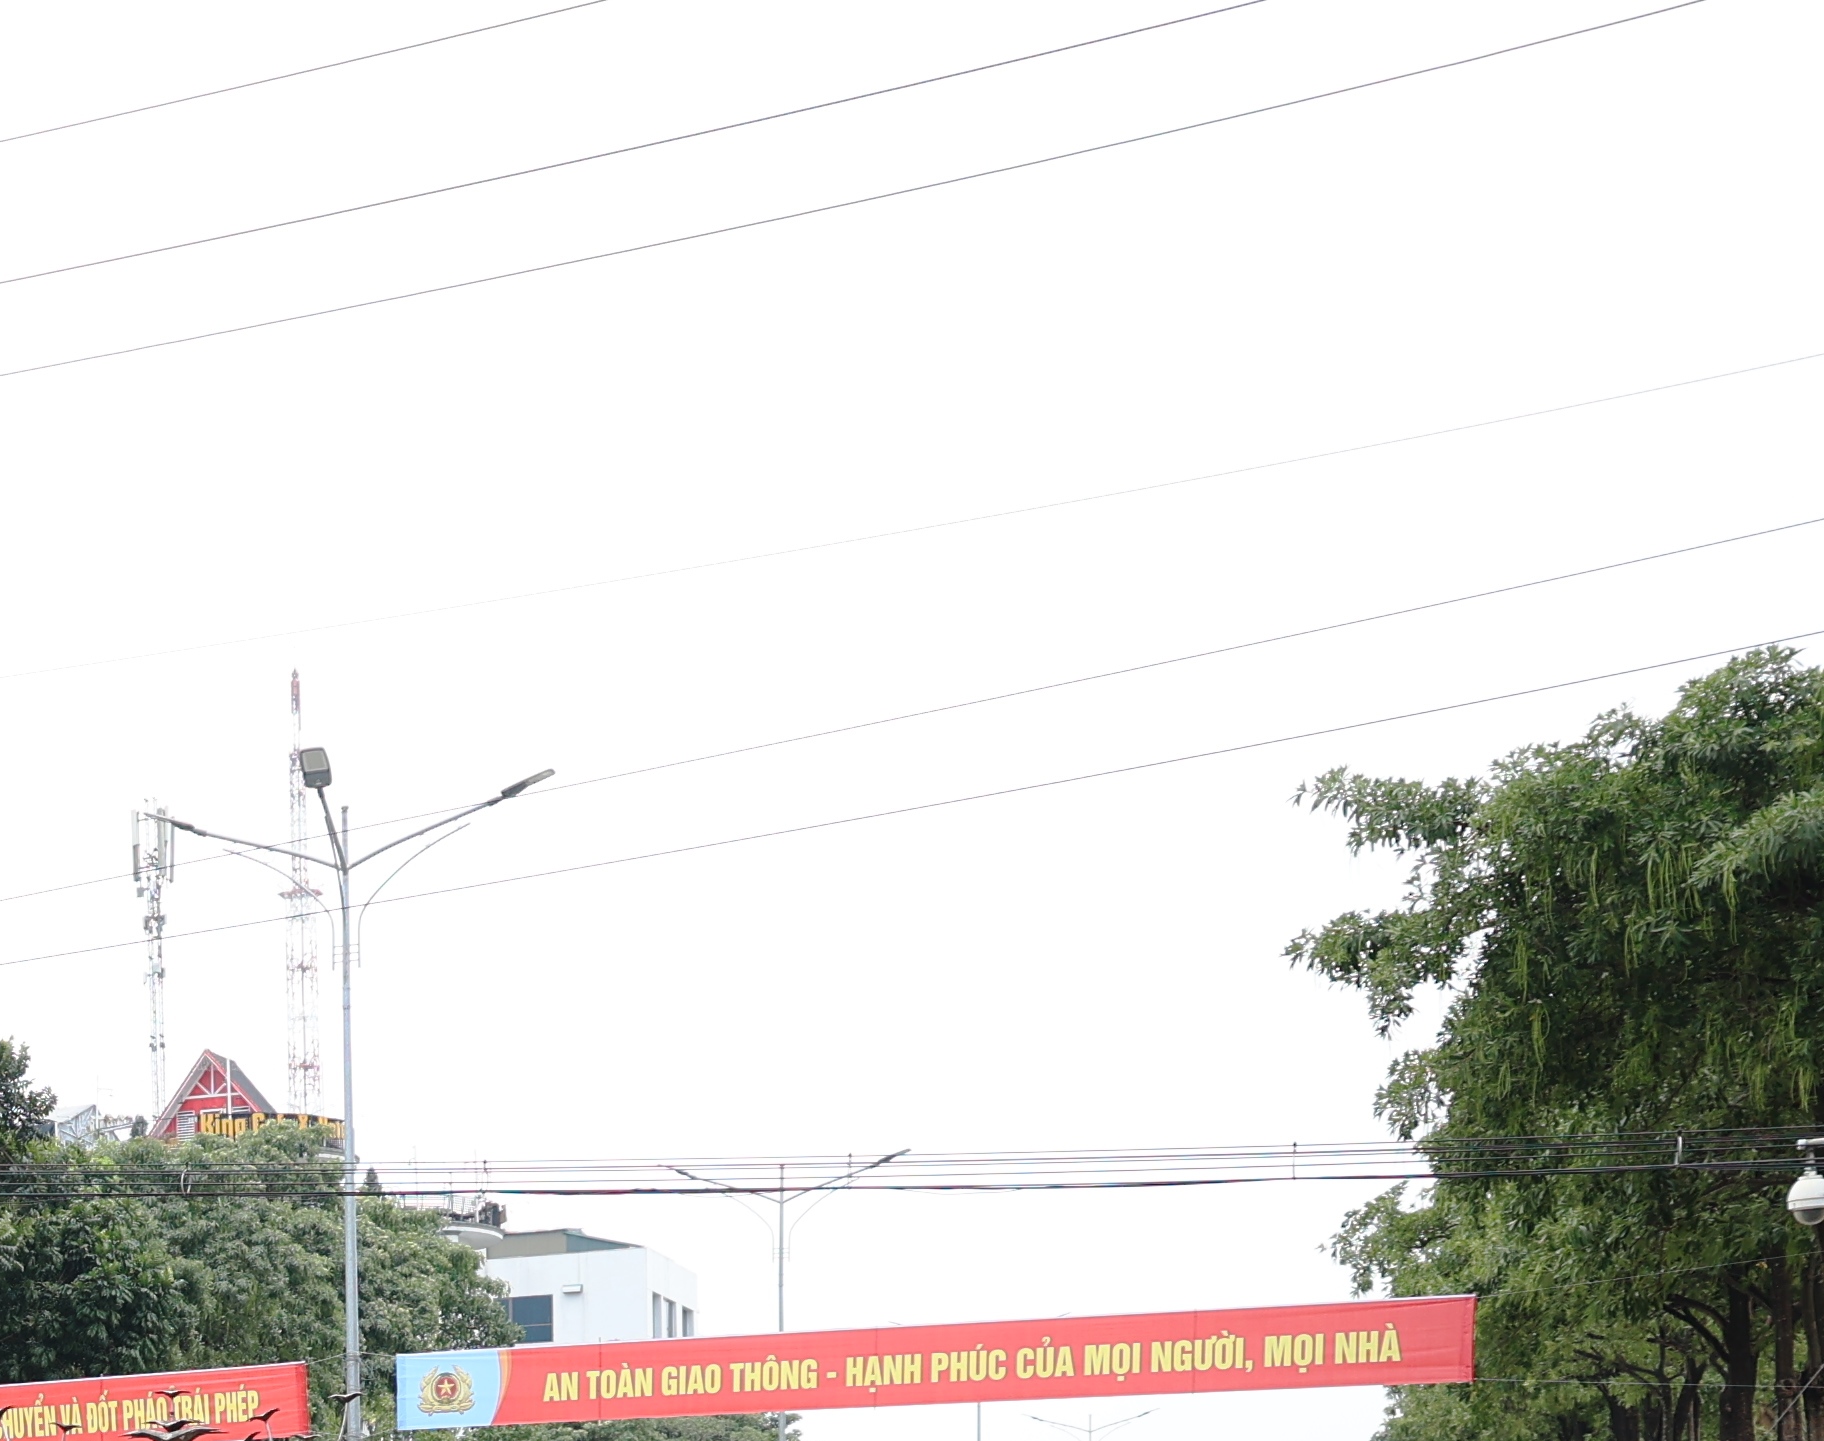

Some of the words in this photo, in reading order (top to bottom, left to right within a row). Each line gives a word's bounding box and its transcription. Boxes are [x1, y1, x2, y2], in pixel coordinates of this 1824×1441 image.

[543, 1371, 579, 1402] AN
[586, 1362, 653, 1399] TOÀN
[661, 1364, 721, 1396] GIAO
[729, 1354, 818, 1392] THÔNG
[845, 1353, 922, 1393] HẠNH
[931, 1343, 1007, 1382] PHÚC
[1016, 1336, 1075, 1379] CỦA
[1083, 1342, 1141, 1382] MỌI
[1151, 1330, 1254, 1373] NGƯỜI,
[1264, 1333, 1324, 1374] MỌI
[1334, 1323, 1401, 1365] NHÀ
[60, 1396, 83, 1436] VÀ
[86, 1389, 118, 1434] ĐỐT
[122, 1391, 168, 1431] PHÁO
[173, 1387, 210, 1426] TRÁI
[214, 1383, 259, 1424] PHÉP
